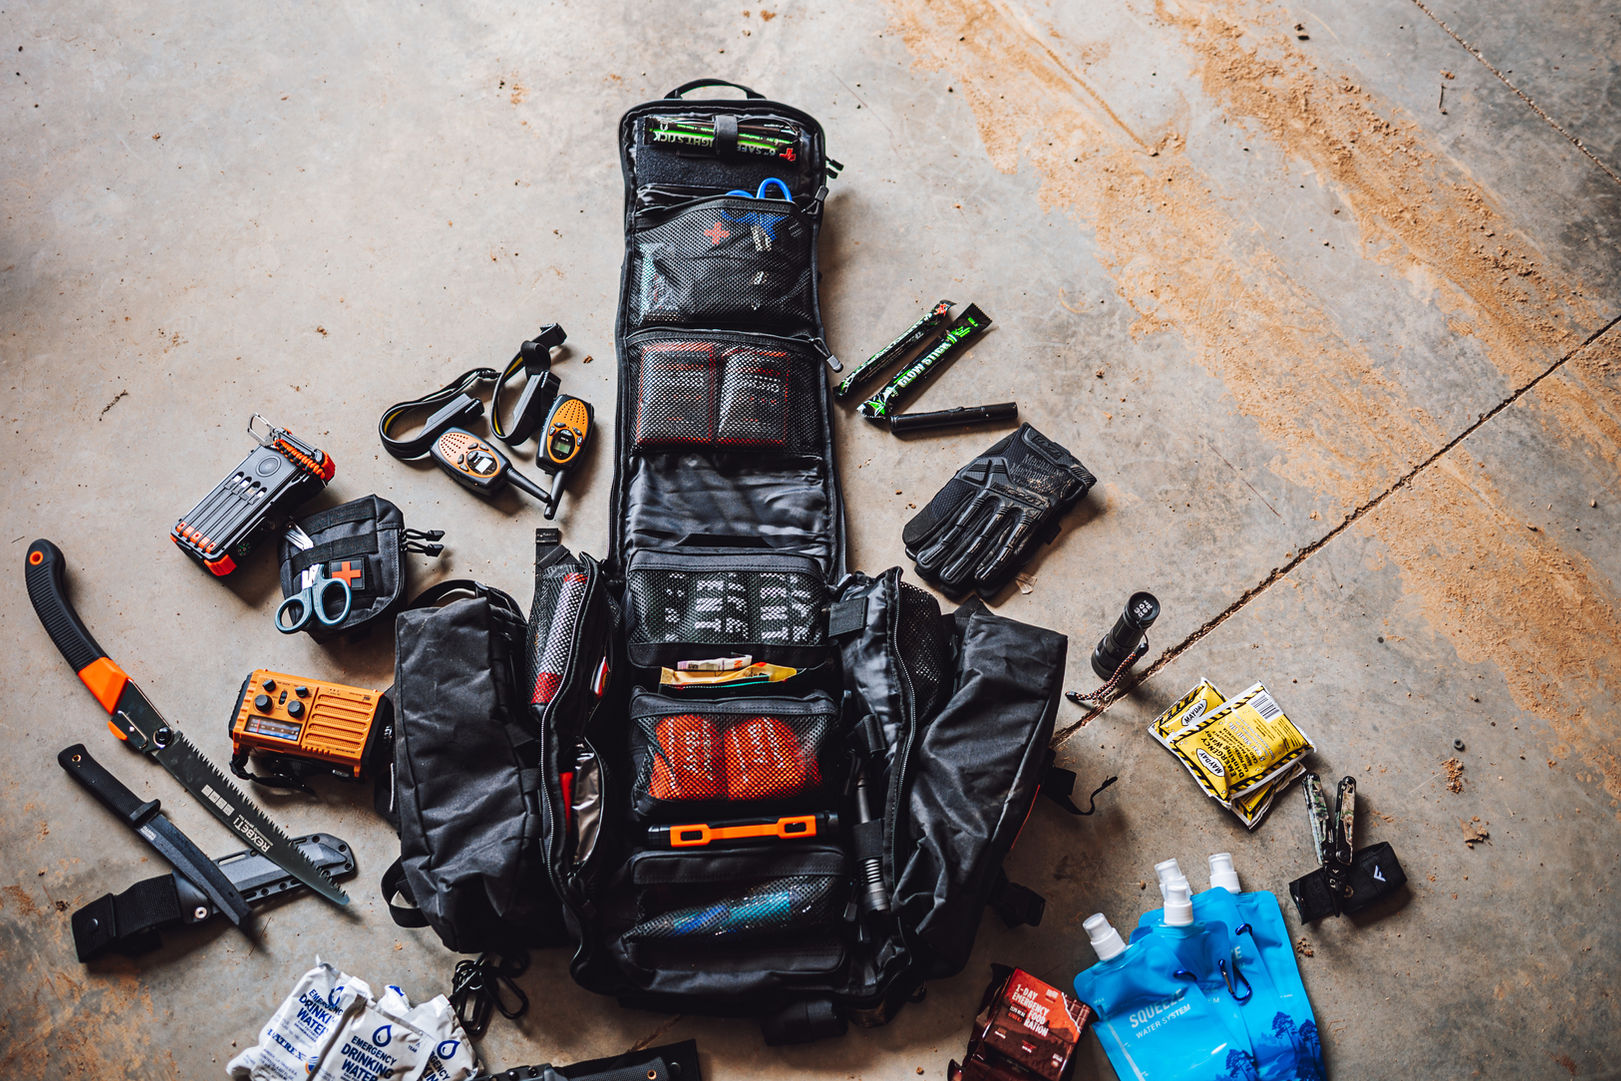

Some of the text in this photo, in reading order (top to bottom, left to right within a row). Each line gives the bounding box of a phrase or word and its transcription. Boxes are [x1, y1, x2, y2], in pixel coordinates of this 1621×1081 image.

[686, 135, 712, 147] IGHT
[735, 143, 762, 154] SAFE
[897, 340, 951, 388] GLOW STICK
[1183, 702, 1203, 723] MAYDAY
[1204, 731, 1222, 748] Water
[1199, 752, 1222, 773] MAYDAY
[1201, 738, 1236, 777] EMERGENCY
[1222, 745, 1244, 778] Drinking
[232, 817, 270, 852] REXBETI
[308, 988, 343, 1016] EMERGENC
[1012, 992, 1050, 1016] EMERGENCY
[1016, 984, 1038, 1000] 1-DAY
[298, 993, 337, 1024] DRINKI
[1028, 1009, 1046, 1024] FOOD
[1136, 1003, 1192, 1039] WATER SYSTEM
[1024, 1018, 1050, 1037] RATION
[340, 1043, 395, 1079] DRINKING
[350, 1035, 397, 1066] EMERGENCY
[430, 1051, 451, 1080] RGENCY
